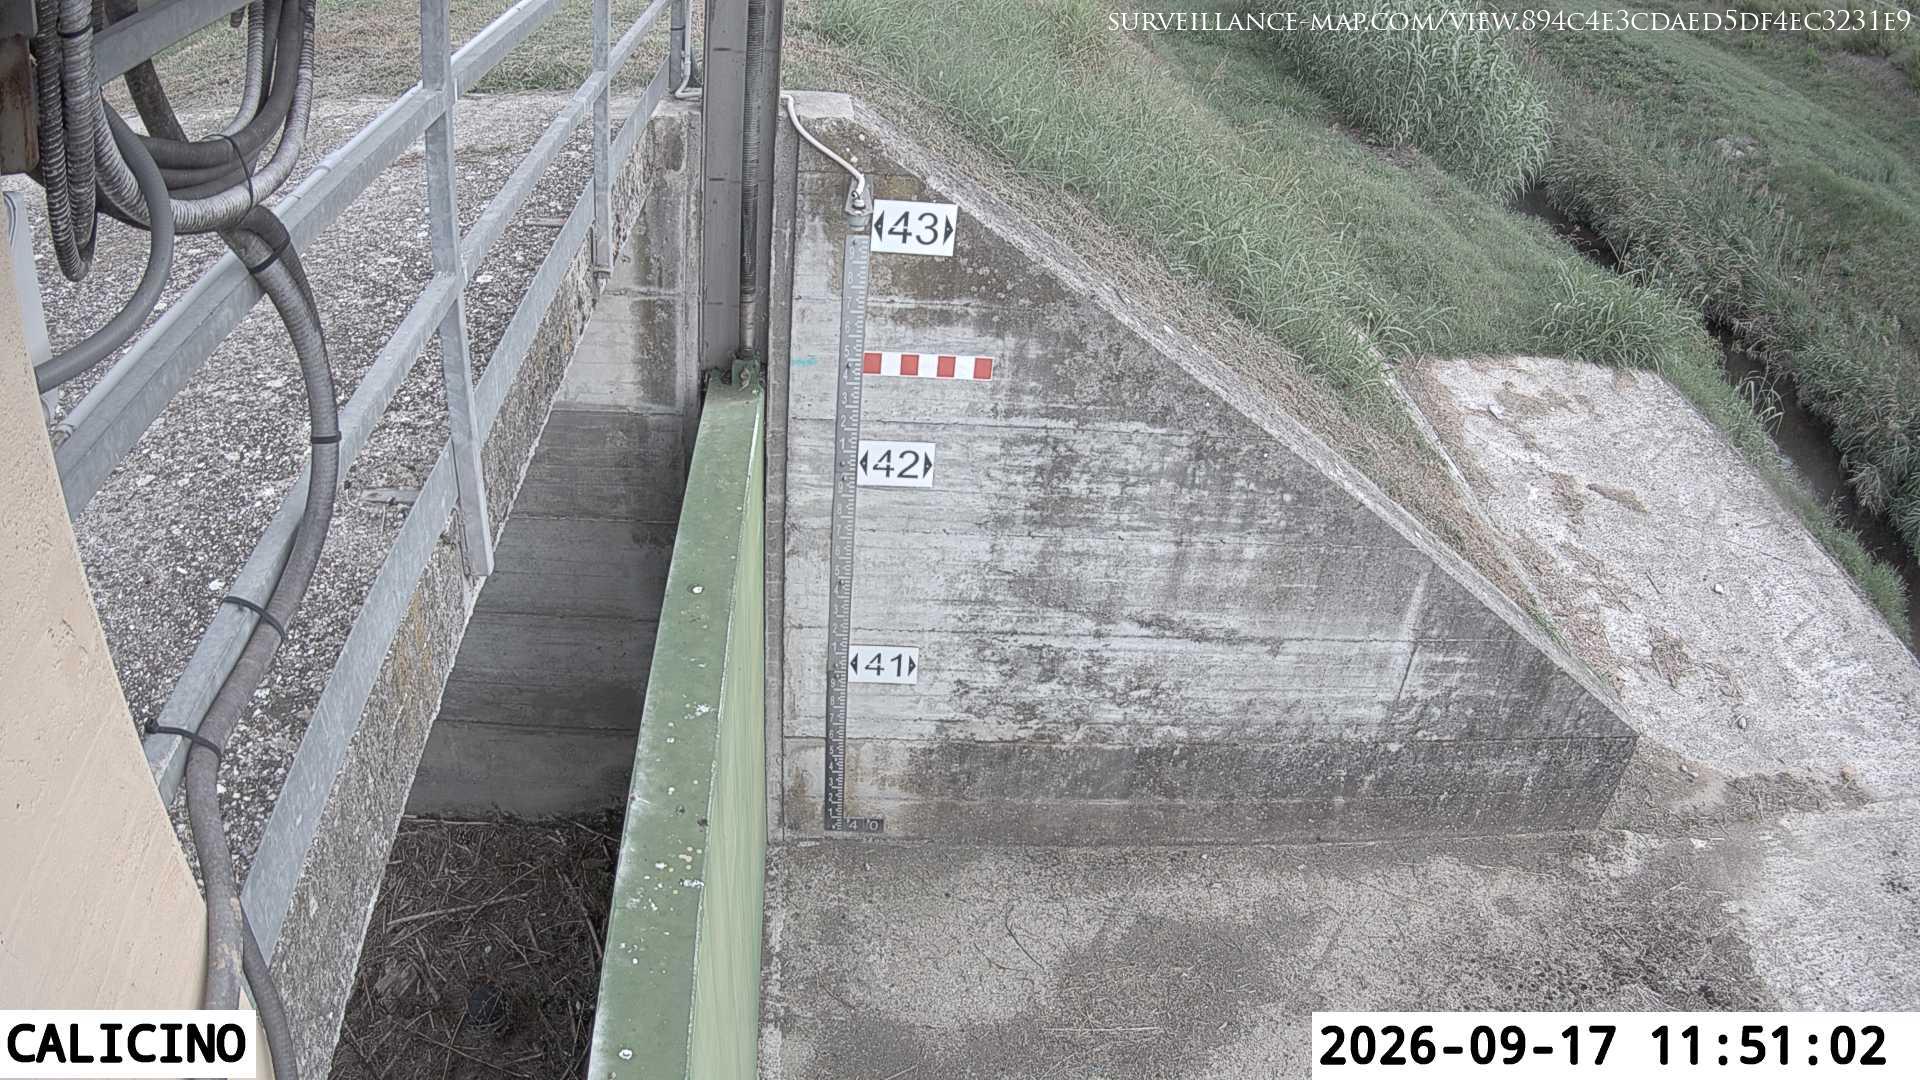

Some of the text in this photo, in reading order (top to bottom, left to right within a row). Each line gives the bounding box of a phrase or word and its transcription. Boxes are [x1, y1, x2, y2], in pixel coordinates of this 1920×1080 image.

[887, 210, 939, 246] 43
[844, 344, 850, 358] 5
[841, 391, 848, 405] 3
[840, 414, 847, 428] 2
[839, 437, 845, 450] 1
[872, 448, 920, 479] 42
[864, 651, 903, 678] 41
